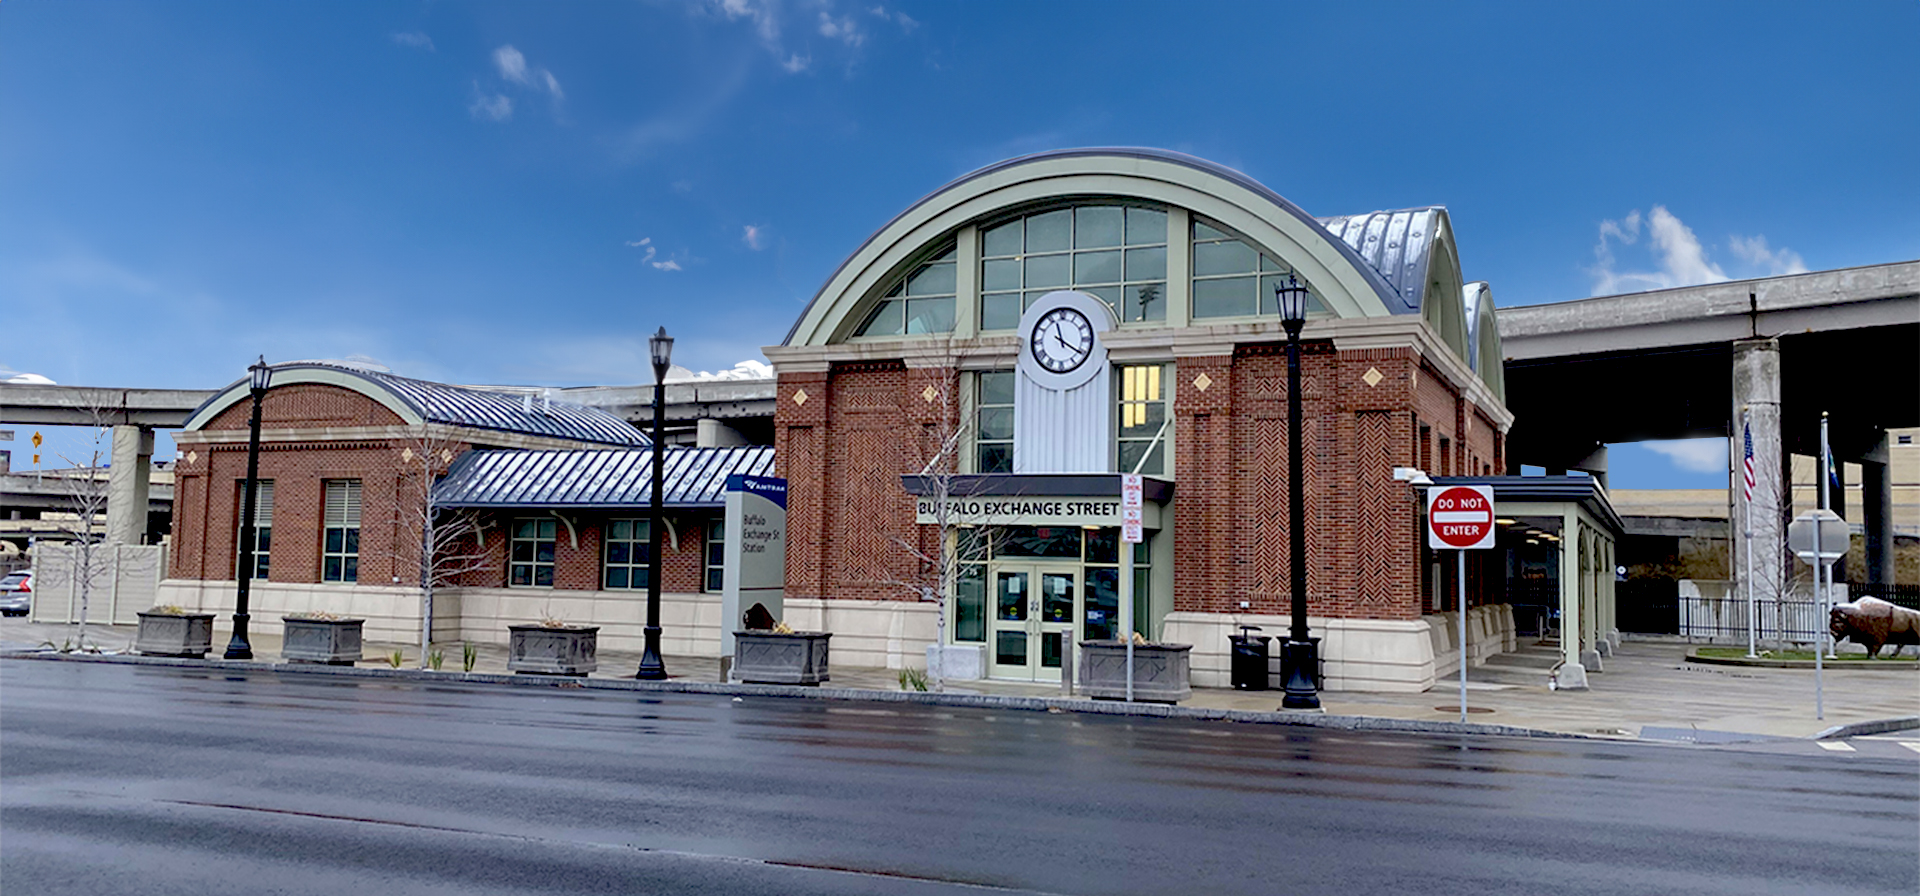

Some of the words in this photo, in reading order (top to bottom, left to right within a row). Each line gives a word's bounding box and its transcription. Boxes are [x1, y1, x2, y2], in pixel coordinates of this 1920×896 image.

[984, 502, 1062, 516] EXCHANGE
[1066, 502, 1120, 516] STREET
[1438, 498, 1454, 509] DO
[1460, 498, 1483, 509] NOT
[744, 514, 766, 526] Buffalo
[743, 528, 772, 543] Exchange
[772, 529, 780, 540] St
[1443, 525, 1479, 536] ENTER
[742, 542, 765, 553] Station
